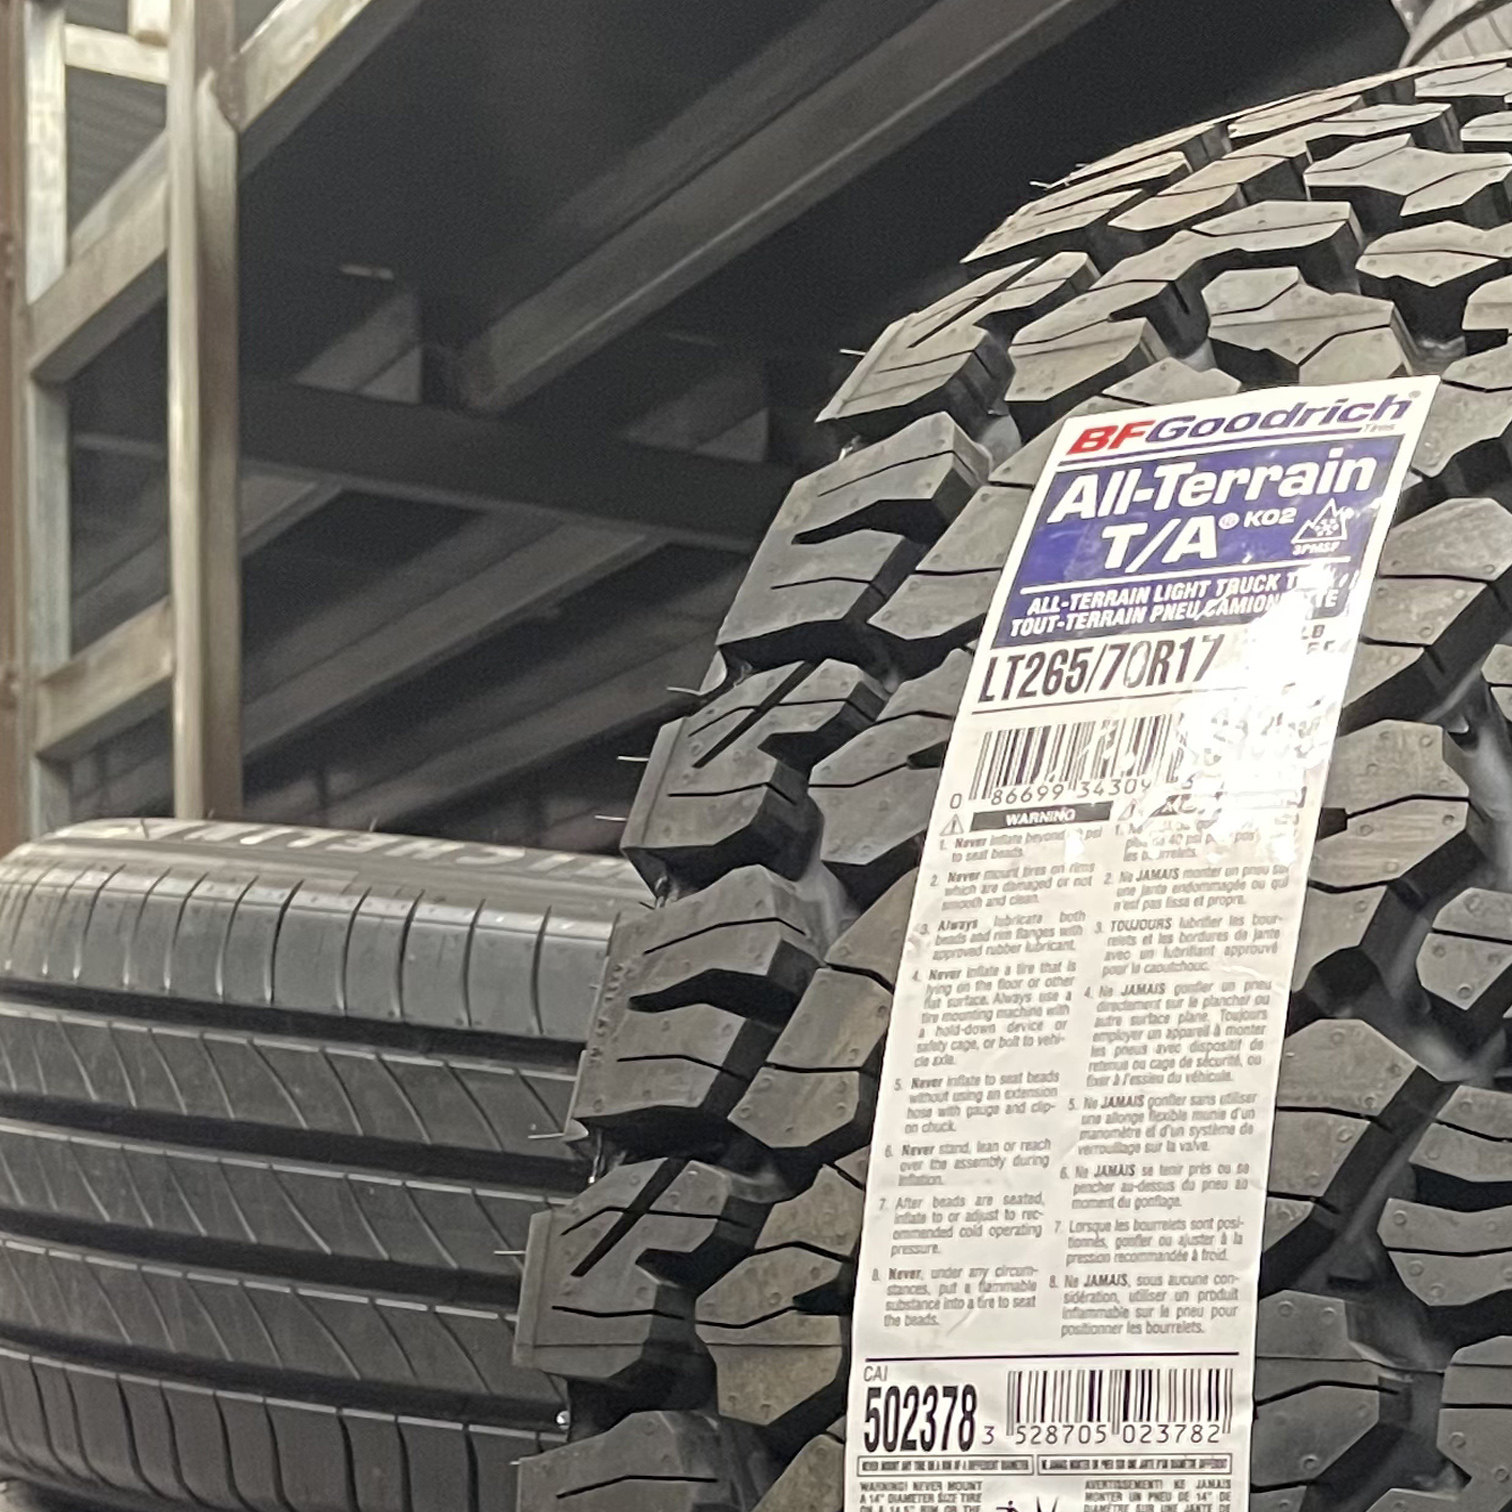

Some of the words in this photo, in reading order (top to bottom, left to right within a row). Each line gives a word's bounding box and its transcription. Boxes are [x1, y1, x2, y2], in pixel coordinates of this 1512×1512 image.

[1066, 394, 1412, 456] BFGoodrich
[1047, 447, 1378, 524] All-Terrain
[1102, 514, 1219, 573] T/A
[1244, 507, 1298, 528] KO2
[1027, 586, 1150, 616] ALL-TERRAIN
[1153, 580, 1212, 604] LIGHT
[1215, 574, 1279, 597] TRUCK
[1010, 608, 1145, 637] TOUT-TERRAIN
[977, 634, 1225, 703] LT265/70R17
[949, 793, 963, 810] 0
[990, 783, 1064, 806] 86699
[1006, 808, 1076, 826] WARNING
[863, 1366, 888, 1383] CAI
[863, 1384, 977, 1453] 502378
[982, 1426, 995, 1445] 3
[1014, 1424, 1107, 1445] 528705
[1122, 1424, 1220, 1444] 023782
